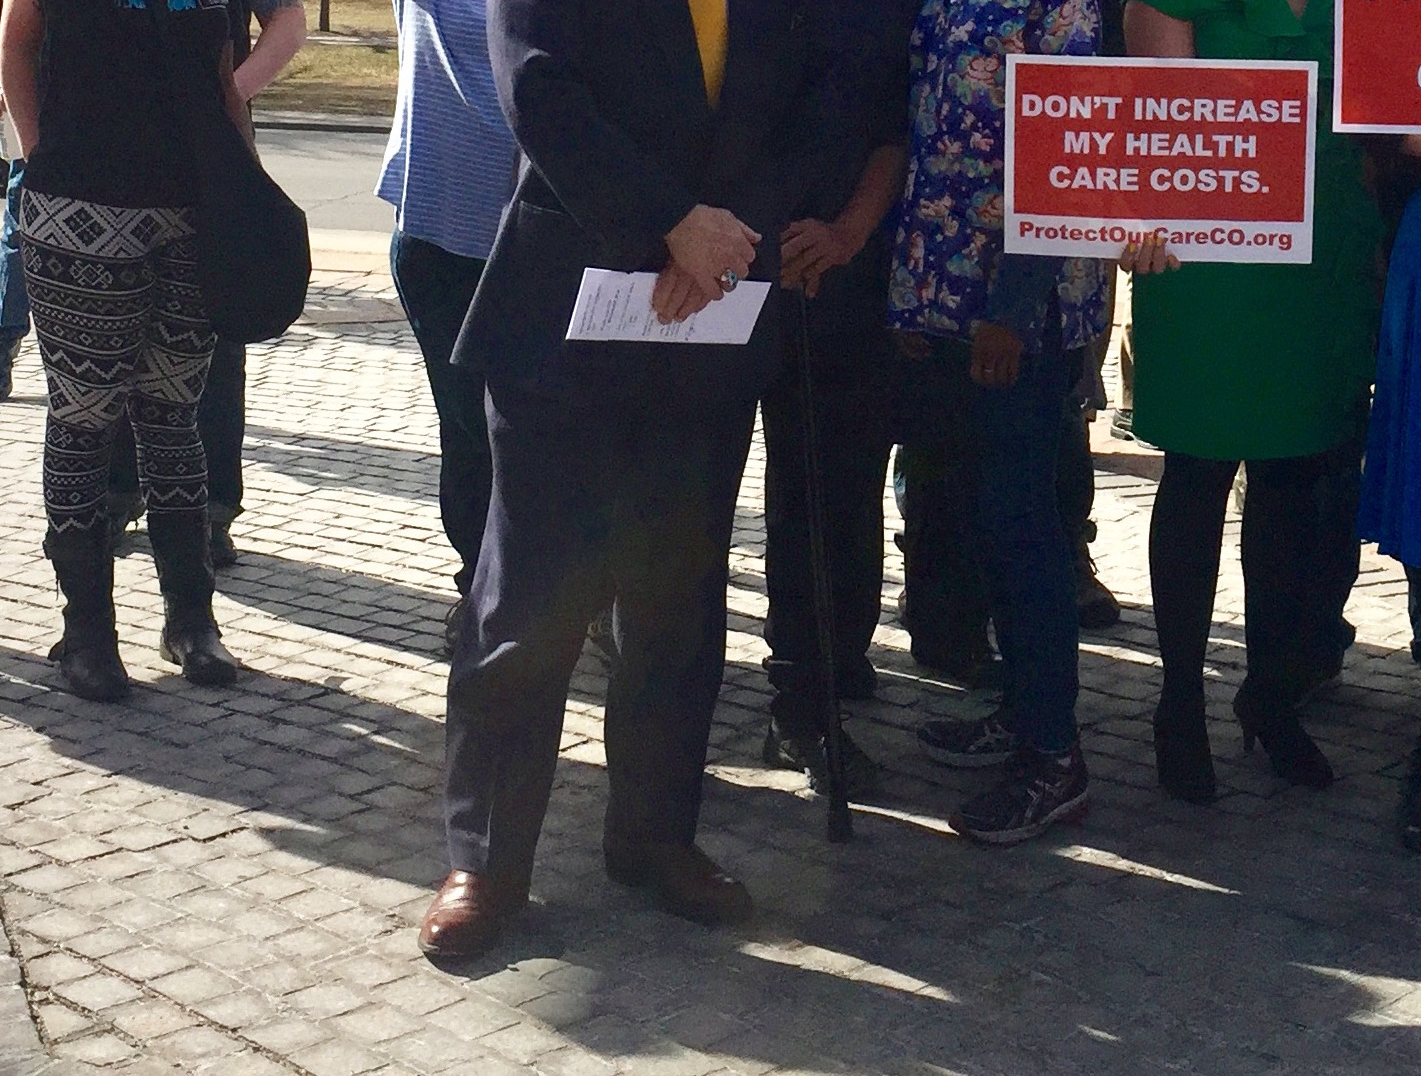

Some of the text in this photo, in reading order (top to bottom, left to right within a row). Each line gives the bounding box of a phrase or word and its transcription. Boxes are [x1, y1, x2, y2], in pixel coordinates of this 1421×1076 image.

[1021, 93, 1301, 123] DON'T INCREASE
[1063, 130, 1257, 158] MY HEALTH
[1049, 165, 1270, 194] CARE COSTS.
